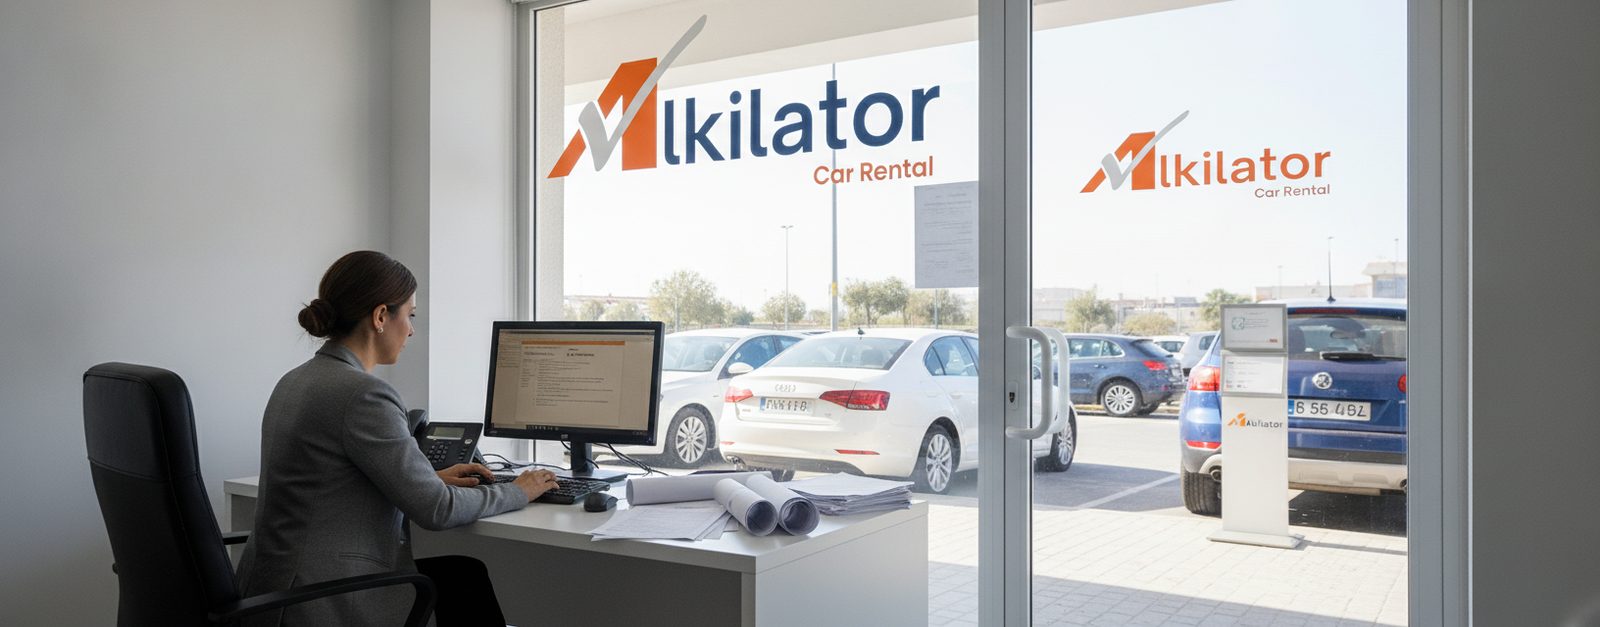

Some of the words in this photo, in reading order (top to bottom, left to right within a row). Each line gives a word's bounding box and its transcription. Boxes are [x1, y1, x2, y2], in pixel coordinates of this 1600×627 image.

[547, 56, 940, 179] Alkilator
[813, 164, 854, 186] Car
[860, 156, 934, 182] Rental
[1079, 130, 1331, 194] Alkilator
[1254, 187, 1280, 199] Car
[1283, 184, 1331, 197] Rental
